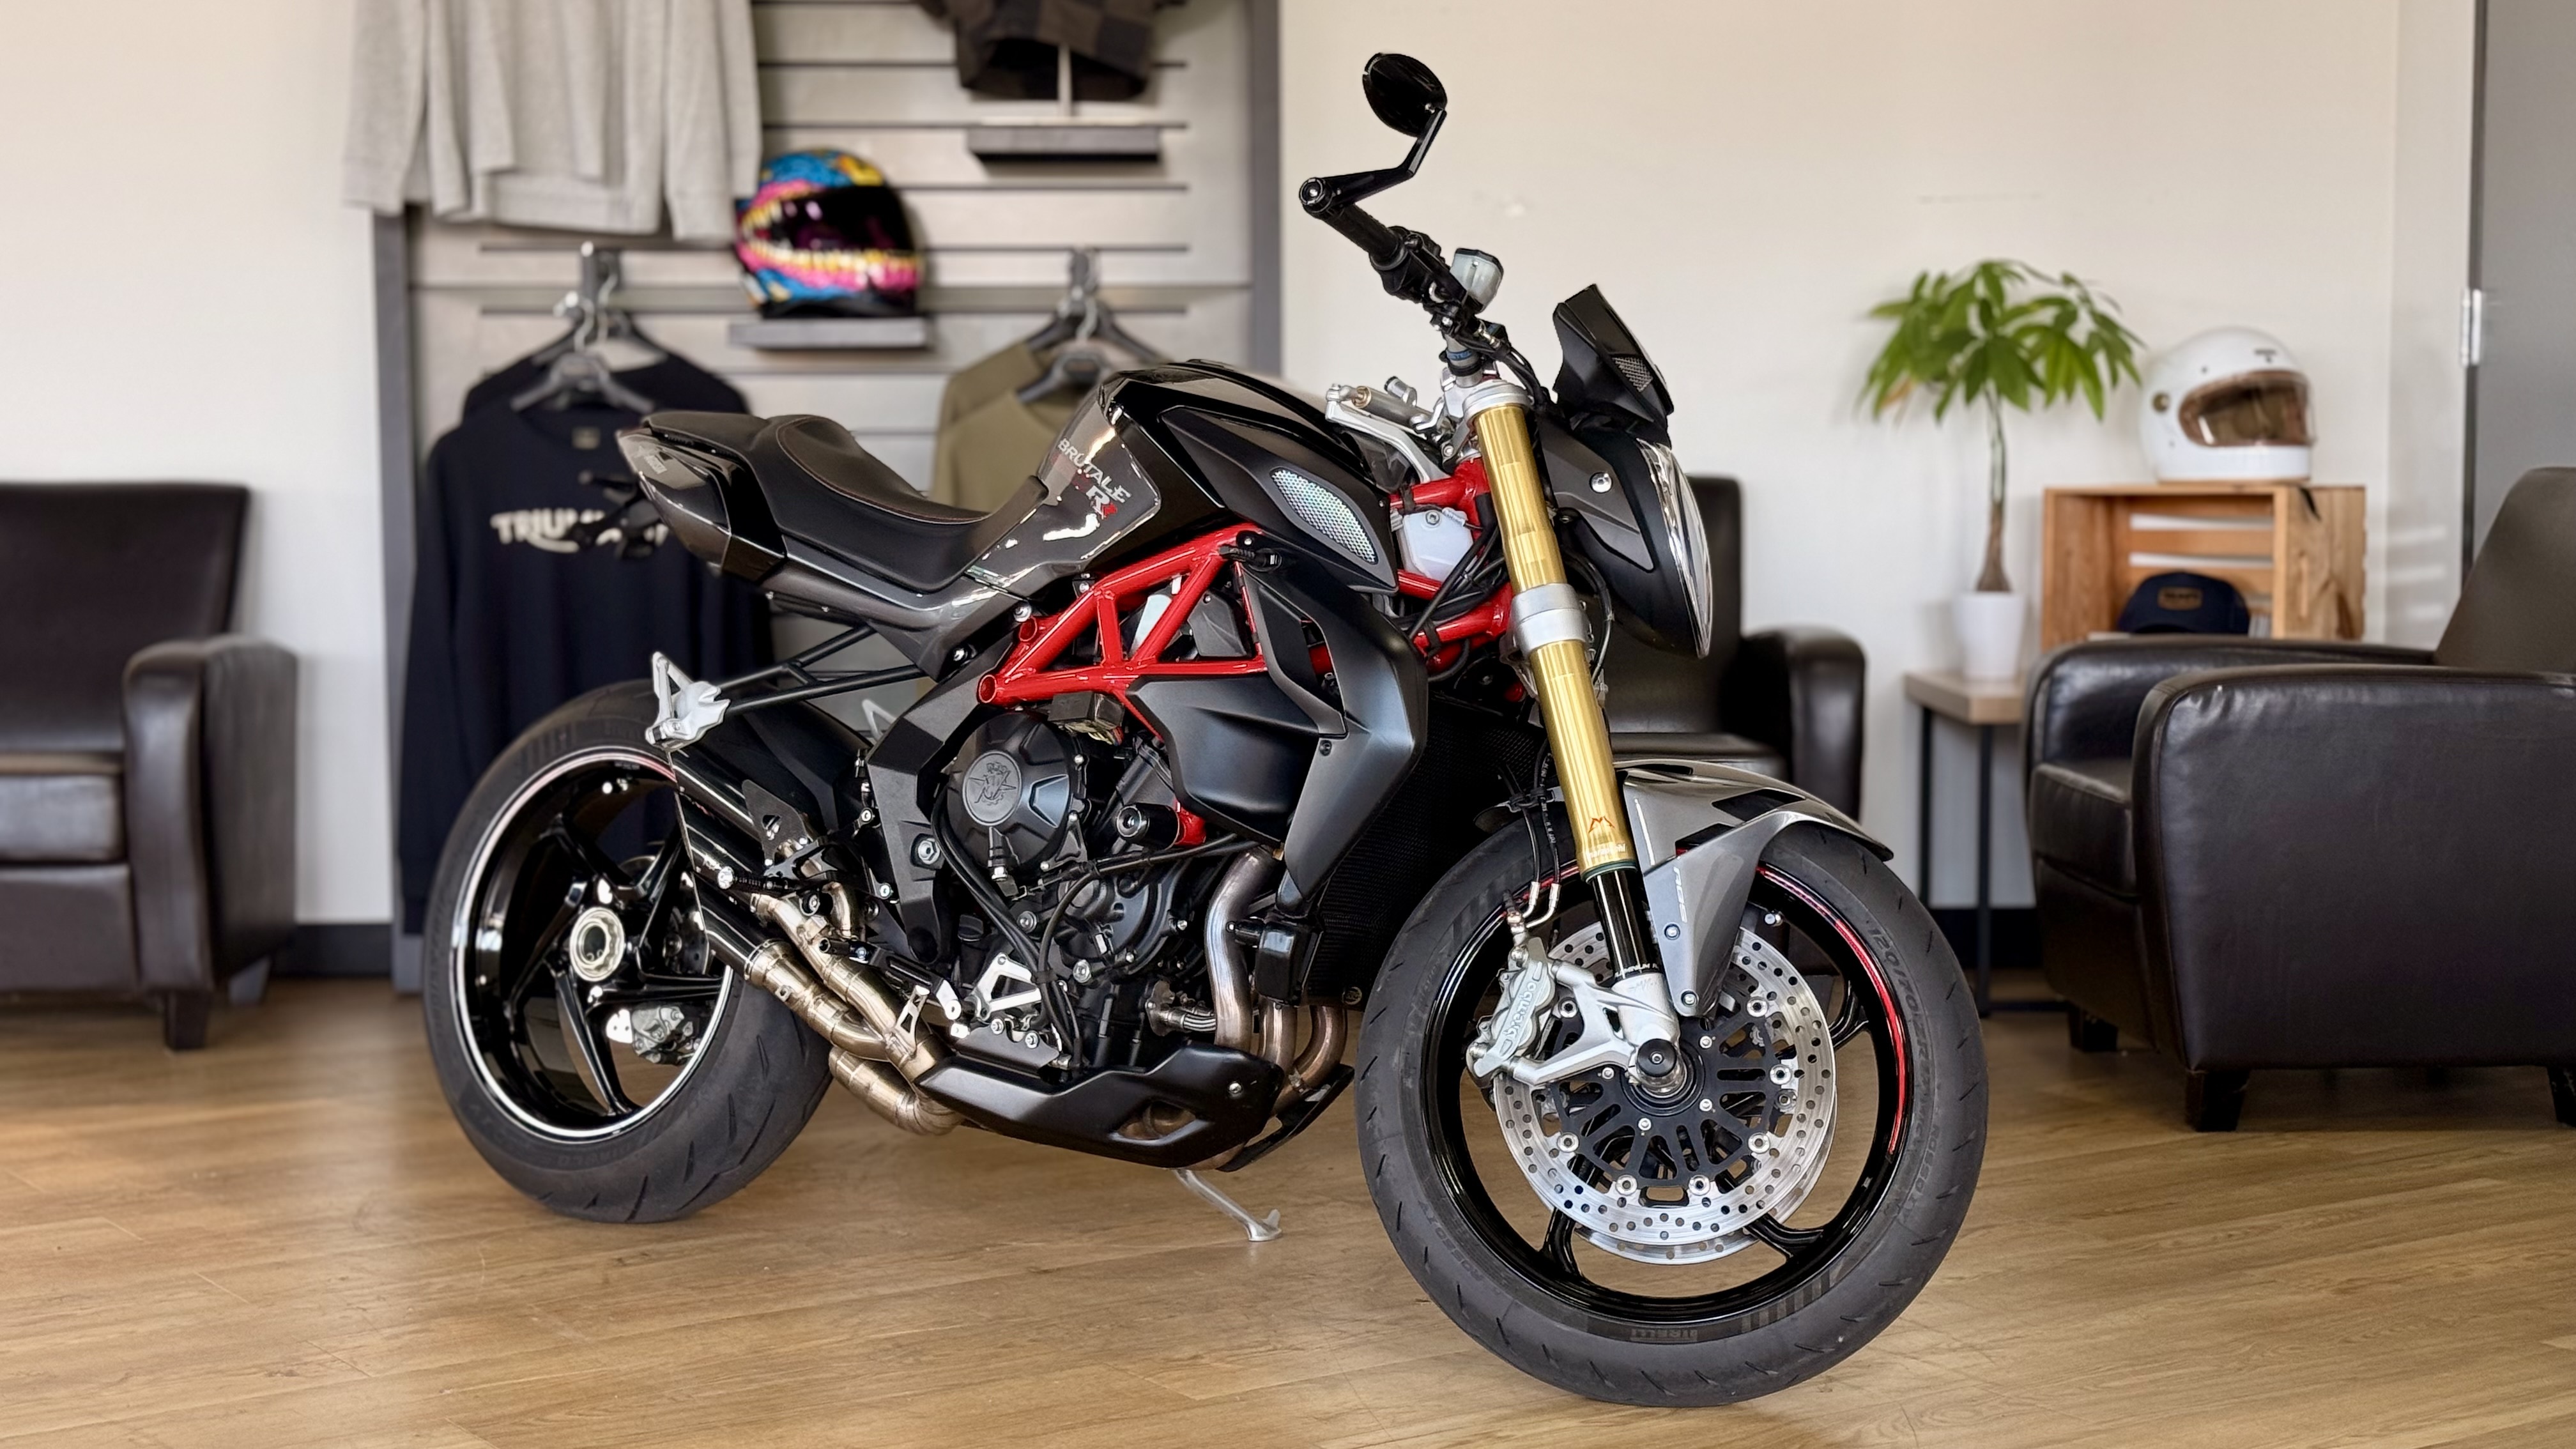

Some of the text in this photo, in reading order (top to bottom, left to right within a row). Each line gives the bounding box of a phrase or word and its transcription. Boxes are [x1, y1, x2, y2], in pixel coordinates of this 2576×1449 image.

[1058, 438, 1131, 503] BRUTALE
[490, 508, 669, 553] TRIU
[1502, 982, 1537, 1038] brembo
